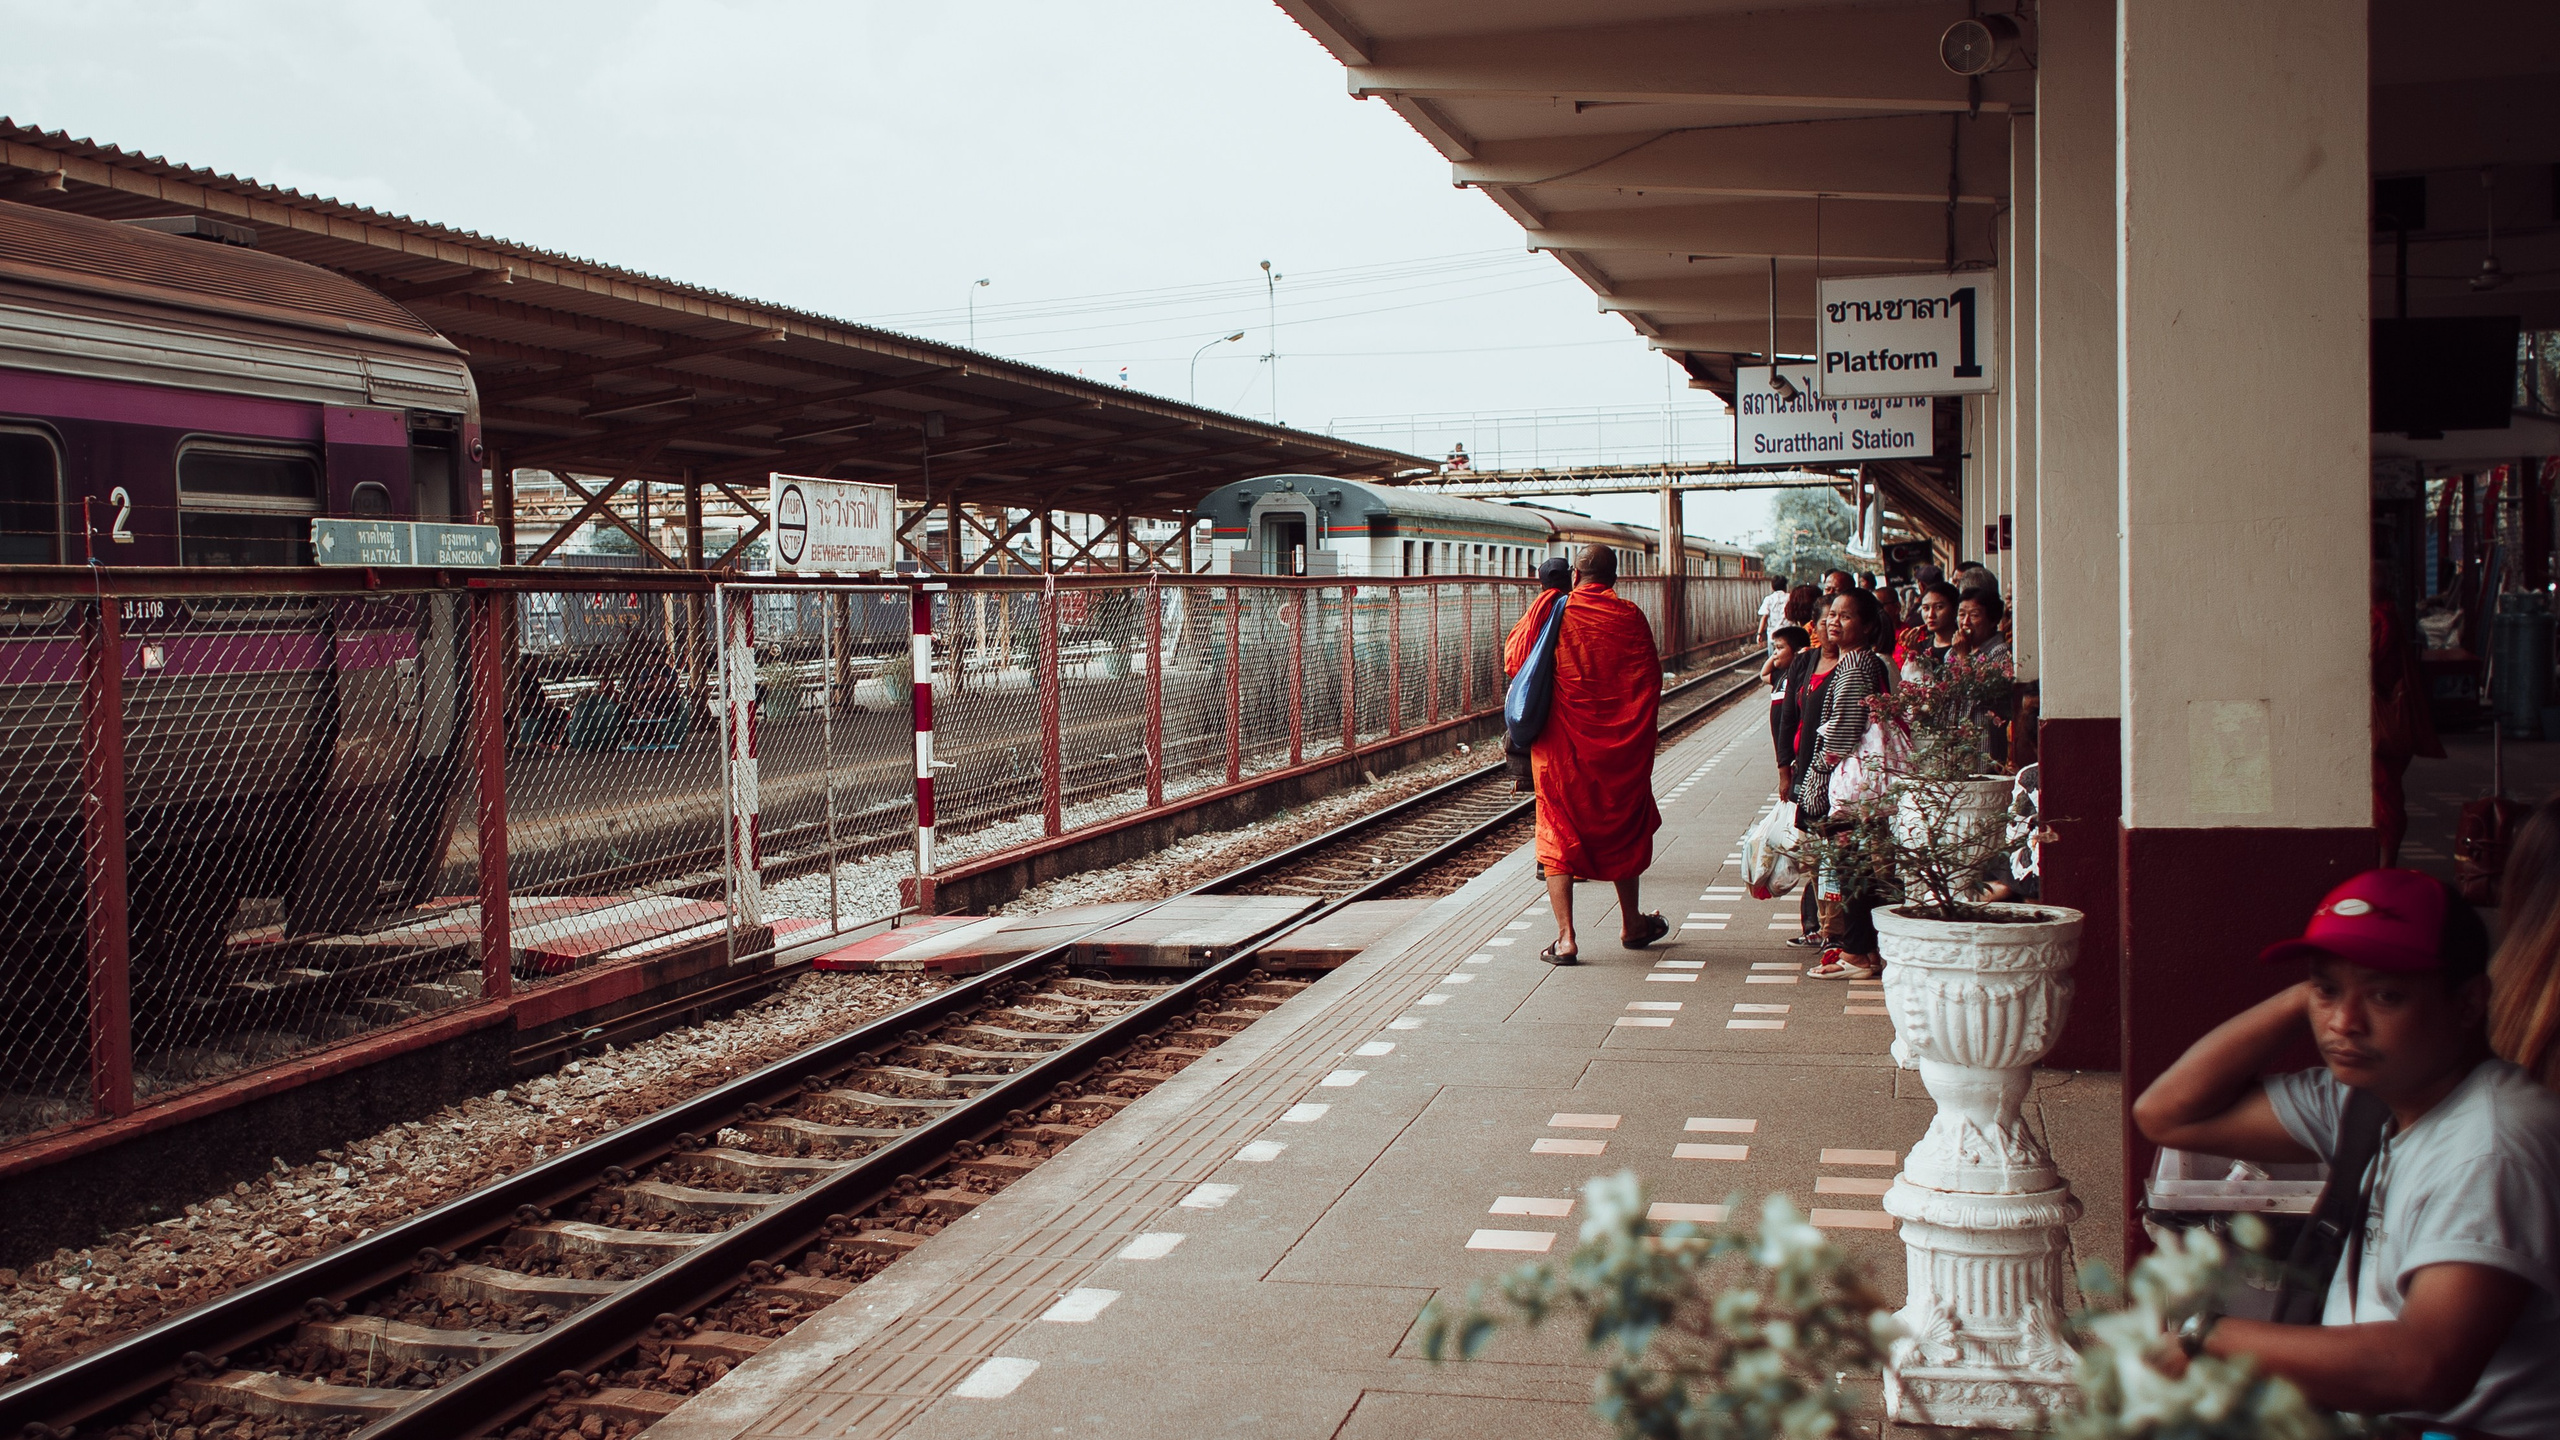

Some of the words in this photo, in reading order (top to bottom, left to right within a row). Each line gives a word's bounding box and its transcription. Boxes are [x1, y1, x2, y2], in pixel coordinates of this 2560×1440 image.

[1826, 297, 1949, 323] ชานชาลา
[1949, 286, 1982, 378] 1
[1826, 348, 1938, 374] Platform
[1754, 431, 1844, 454] Suratthani
[1851, 428, 1915, 450] Station
[110, 486, 135, 543] 2
[784, 497, 801, 522] หยุด
[816, 488, 878, 529] ระวังรถไฟ
[358, 524, 395, 549] หาดใหญ่
[784, 535, 800, 550] STOP
[362, 548, 401, 564] HATYAI
[439, 550, 485, 565] BANGKOK
[811, 543, 847, 561] BEWARE
[847, 545, 861, 562] OF
[861, 545, 886, 563] TRAIN
